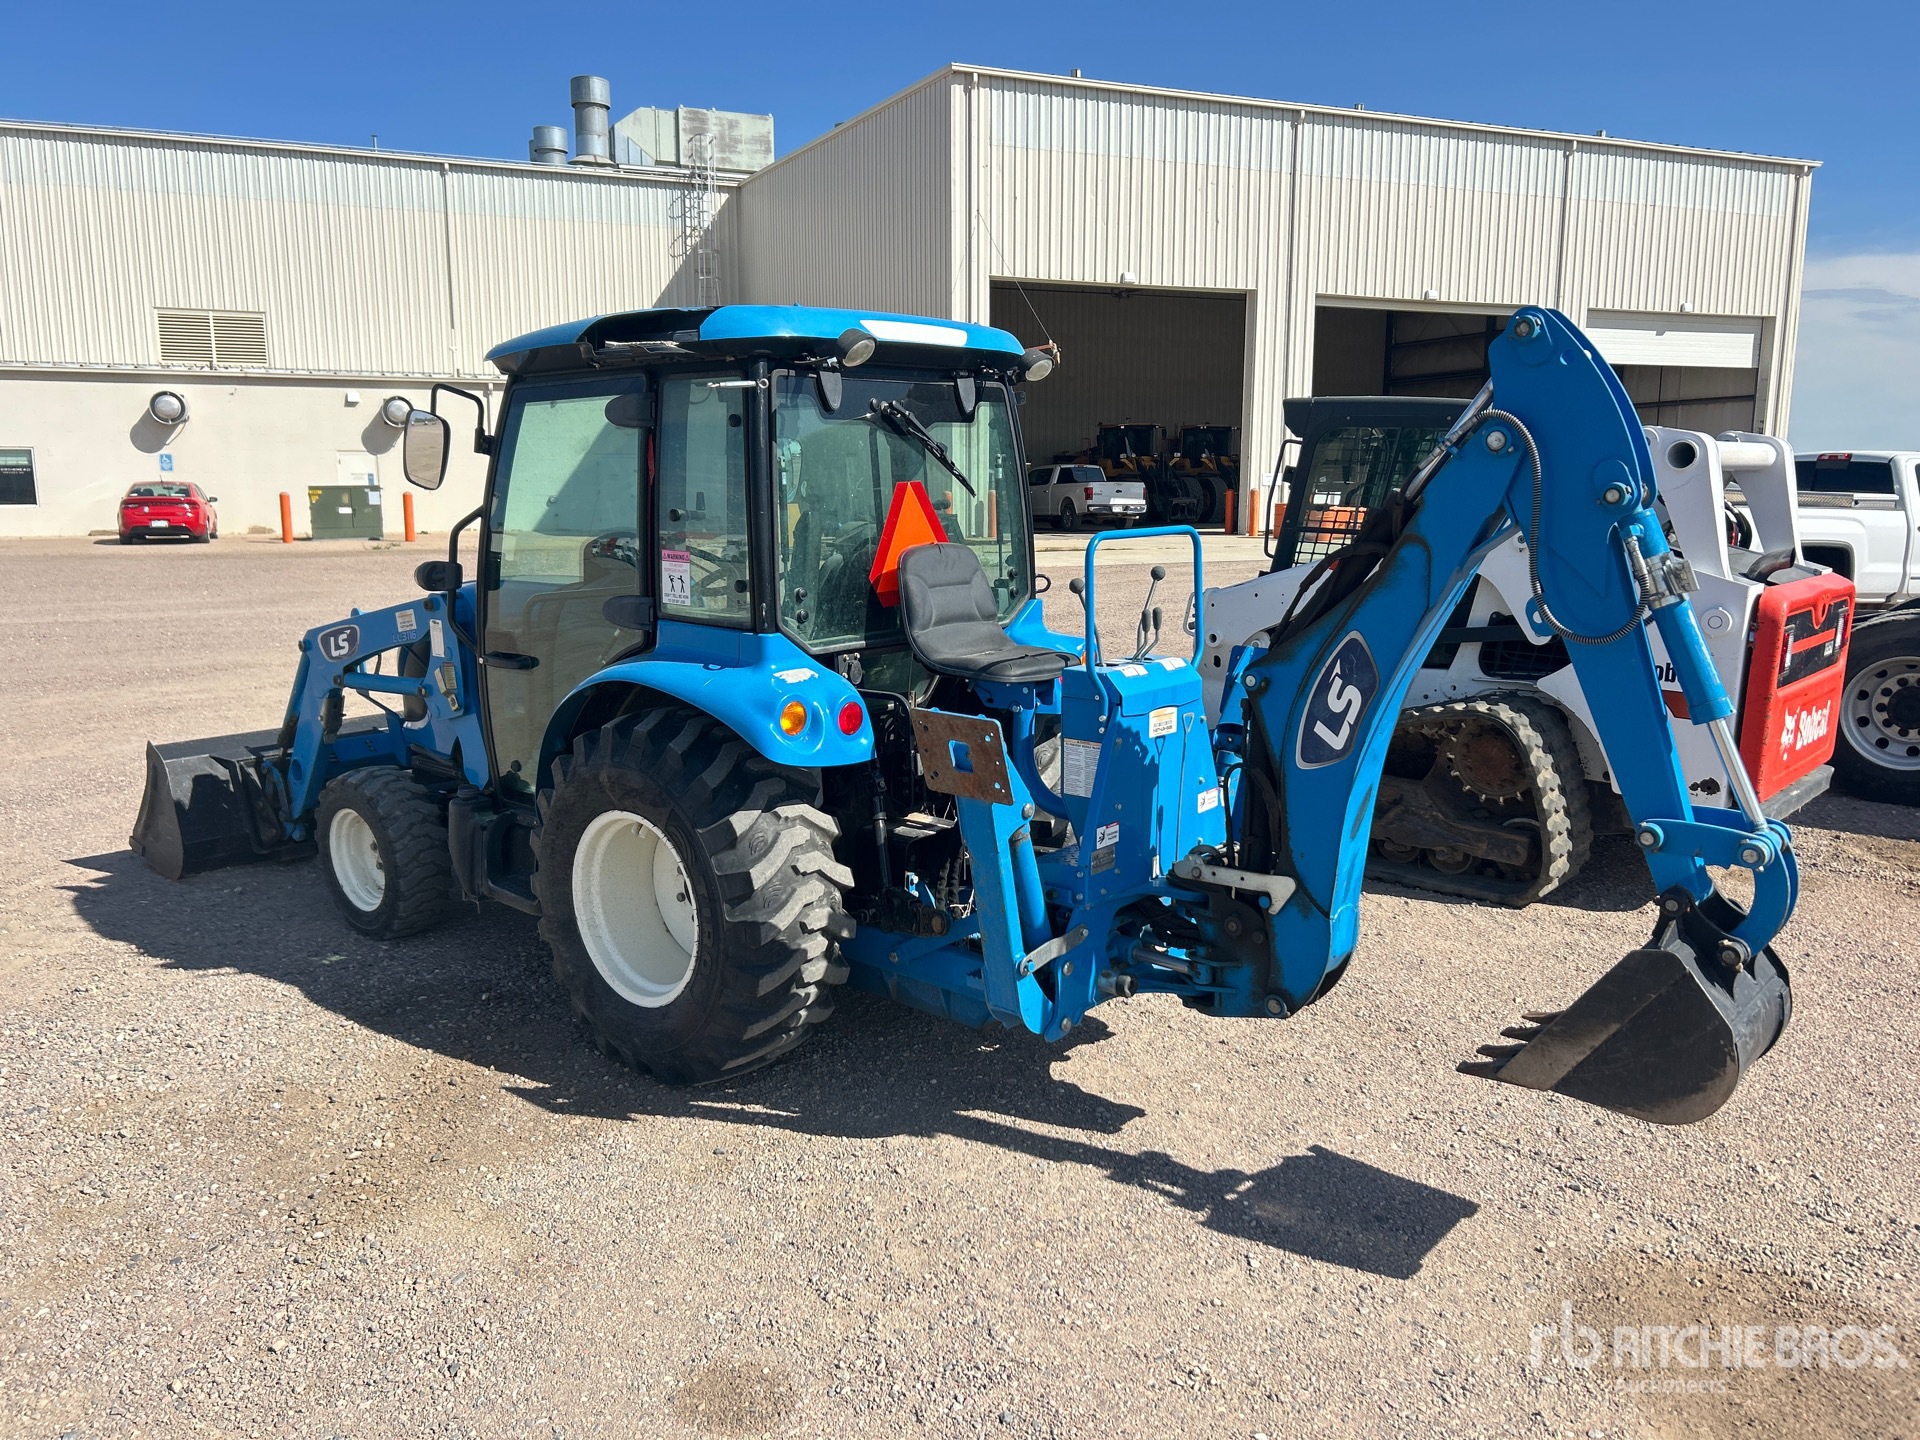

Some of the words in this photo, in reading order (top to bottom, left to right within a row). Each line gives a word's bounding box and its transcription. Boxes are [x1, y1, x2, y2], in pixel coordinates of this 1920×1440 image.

[666, 553, 685, 561] WARNING
[330, 630, 351, 657] LS
[1313, 660, 1362, 750] LS
[1795, 700, 1831, 750] Bobcat
